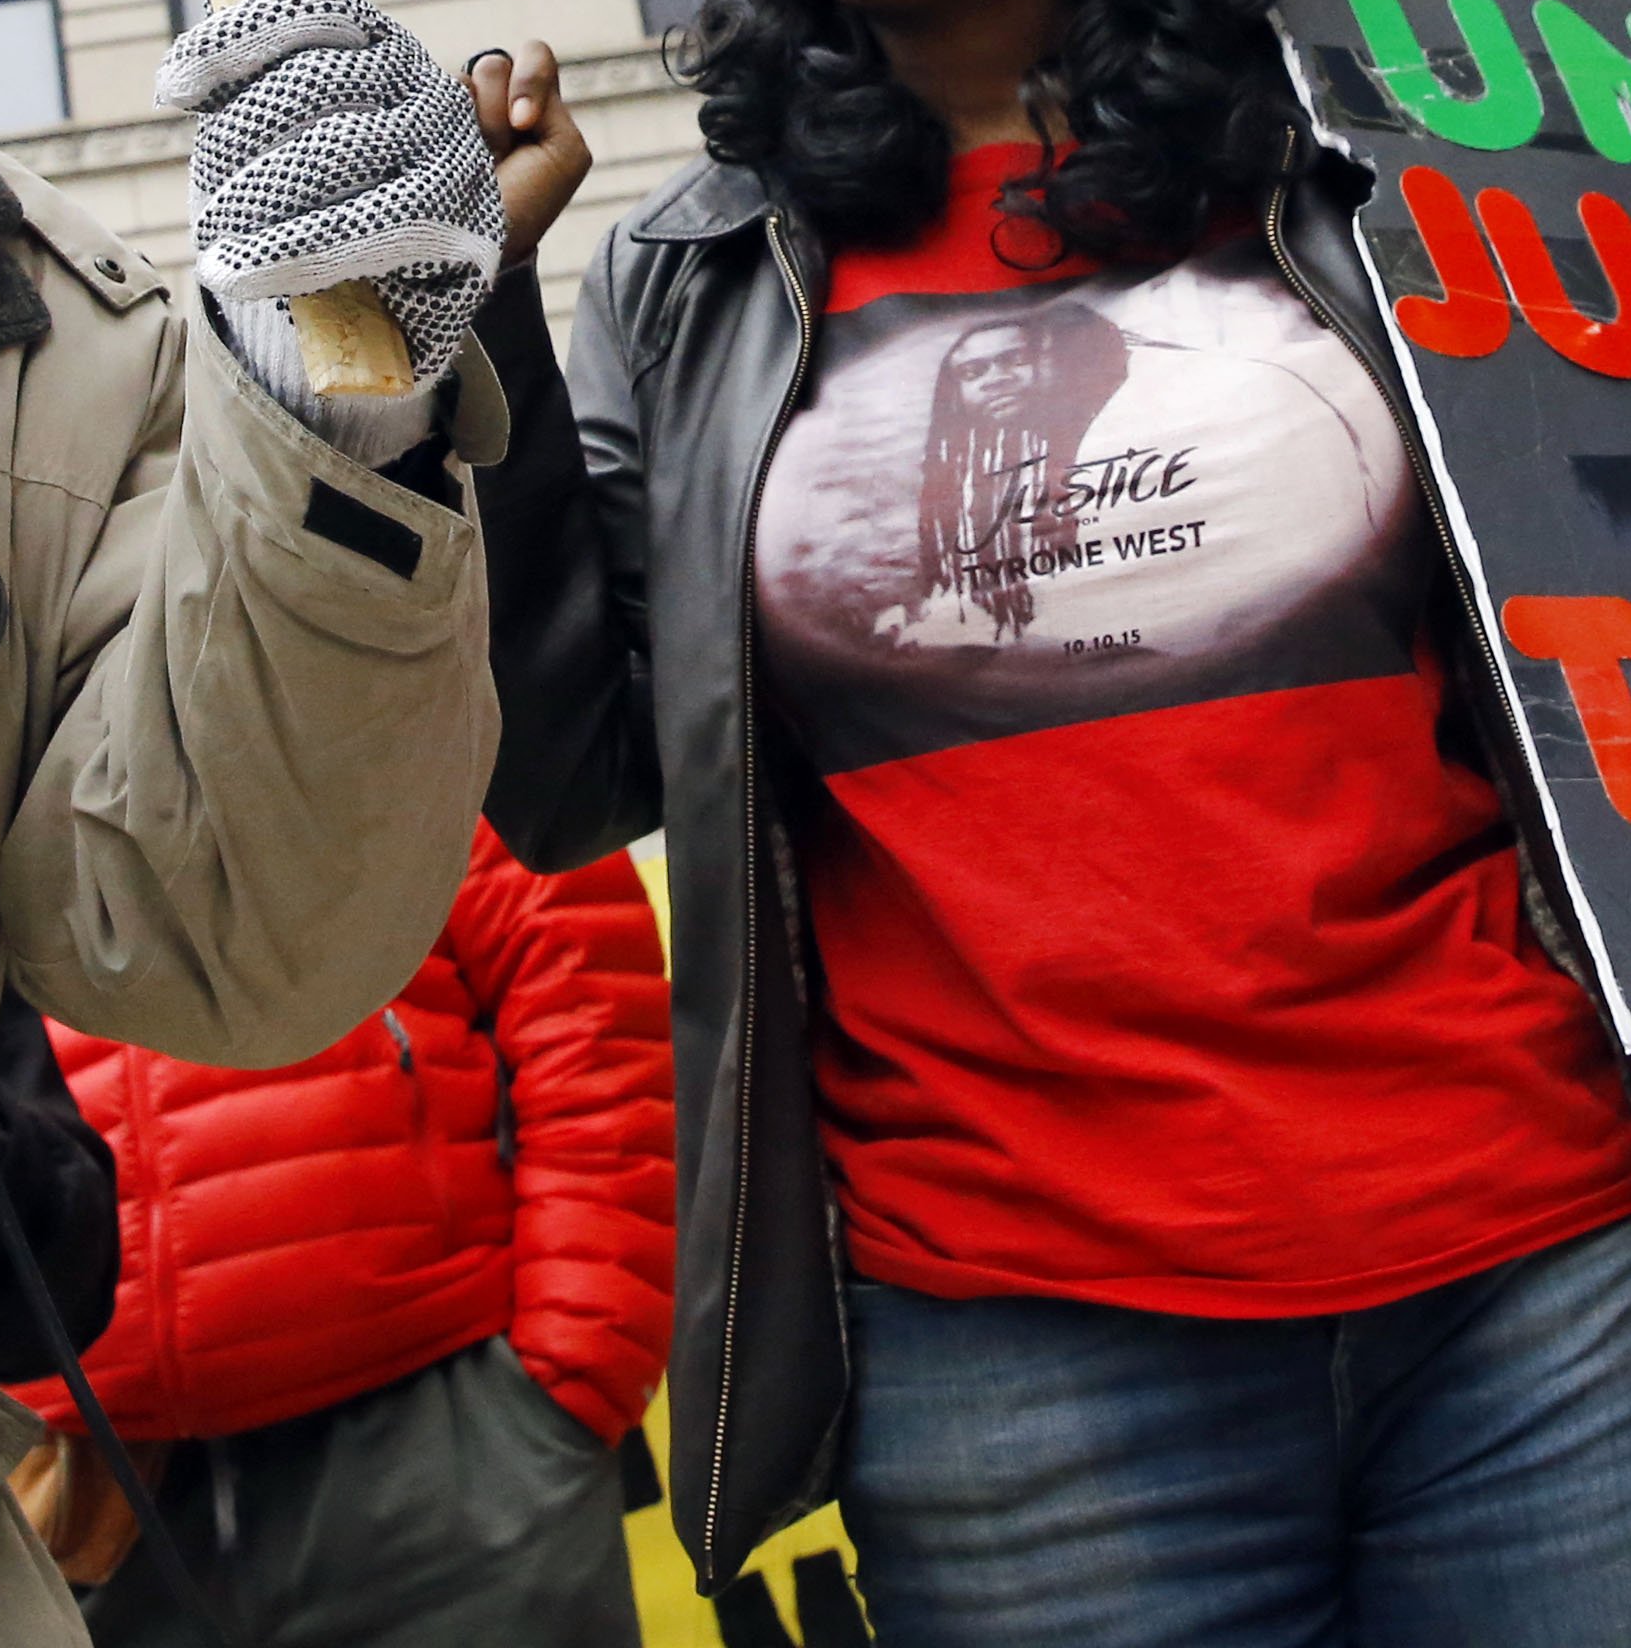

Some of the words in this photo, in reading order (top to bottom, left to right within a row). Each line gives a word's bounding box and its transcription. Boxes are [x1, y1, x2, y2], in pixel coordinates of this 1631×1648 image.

[962, 539, 1105, 590] TYRONE
[1113, 521, 1206, 560] WEST
[1063, 628, 1141, 654] 10.10.15
